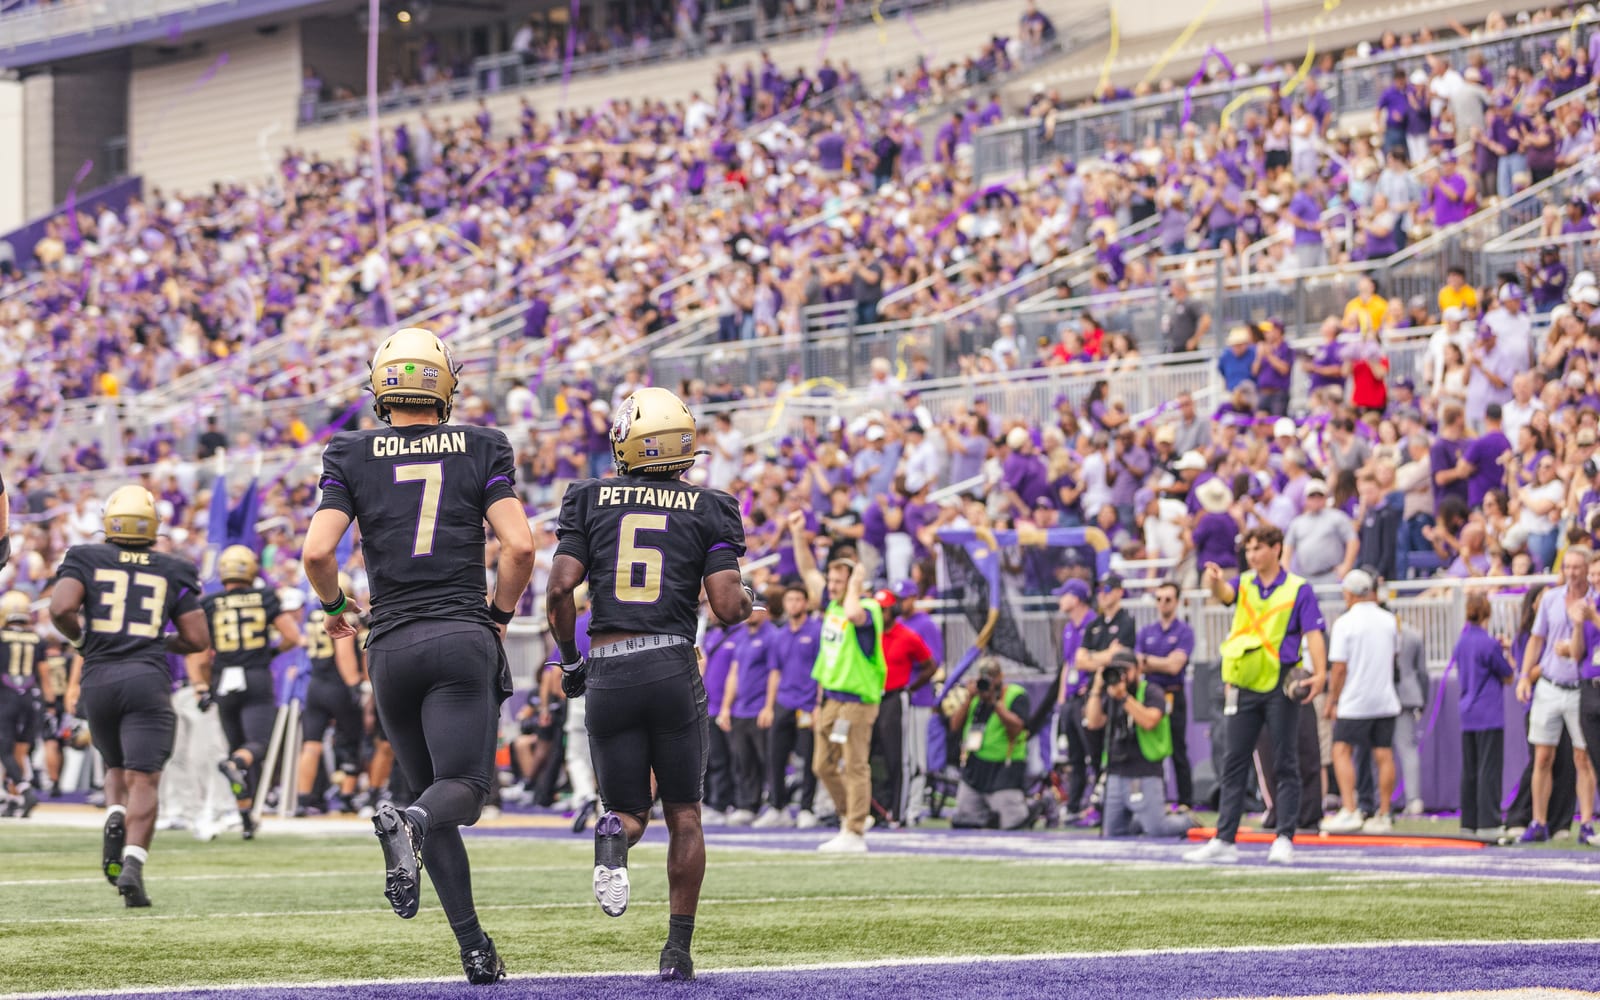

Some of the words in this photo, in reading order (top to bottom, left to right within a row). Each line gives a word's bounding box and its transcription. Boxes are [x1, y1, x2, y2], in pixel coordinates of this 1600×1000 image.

[405, 397, 435, 405] MADISON
[373, 432, 466, 457] COLEMAN
[644, 465, 667, 473] JAMES
[393, 460, 444, 557] 7
[598, 486, 700, 511] PETTAWAY
[119, 551, 150, 565] DYE
[613, 511, 670, 605] 6
[91, 568, 168, 638] 33
[213, 607, 267, 653] 82
[8, 642, 35, 677] 11
